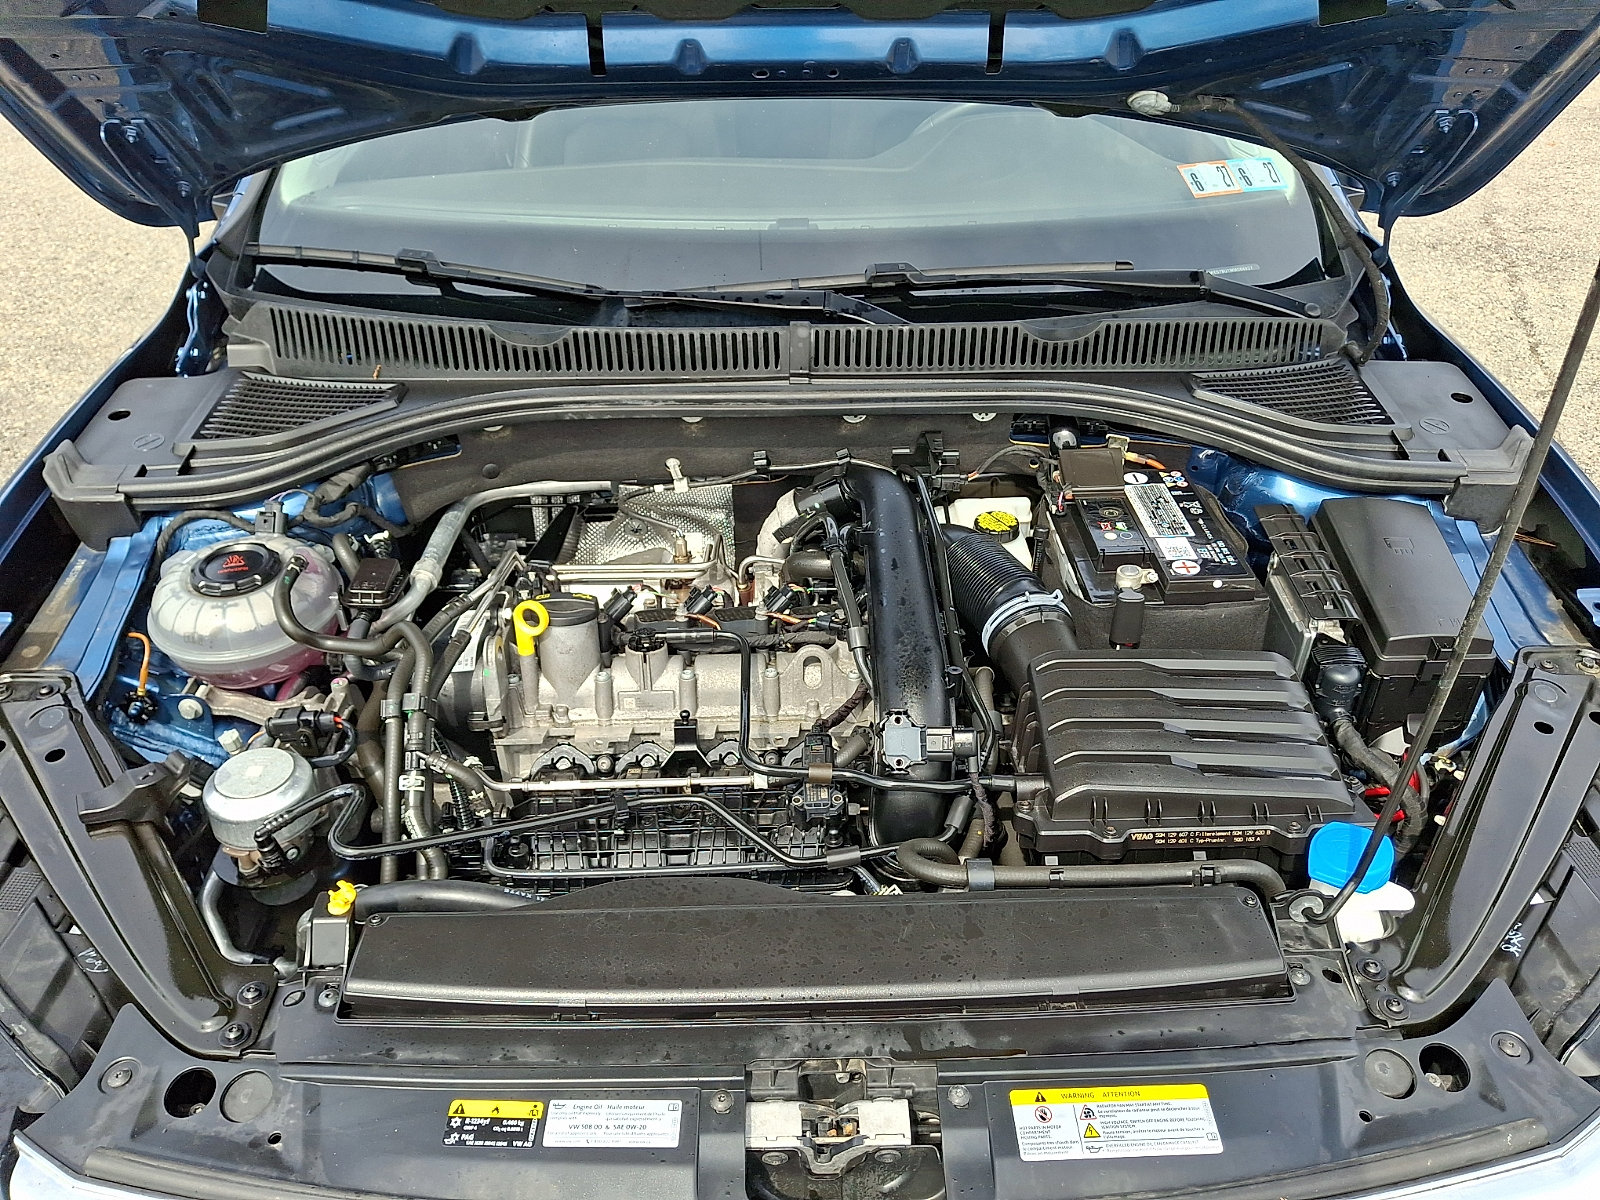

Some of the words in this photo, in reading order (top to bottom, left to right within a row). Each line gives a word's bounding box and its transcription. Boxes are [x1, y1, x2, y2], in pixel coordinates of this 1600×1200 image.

[1189, 172, 1205, 192] 6
[1215, 165, 1235, 188] 27
[1237, 167, 1253, 187] 6
[1262, 161, 1281, 184] 27
[1060, 1091, 1095, 1099] WARNING
[1102, 1090, 1141, 1098] ATTENTION
[573, 1103, 592, 1111] Engine
[594, 1102, 603, 1110] Oil
[607, 1102, 622, 1110] Huile
[460, 1133, 475, 1141] PAG
